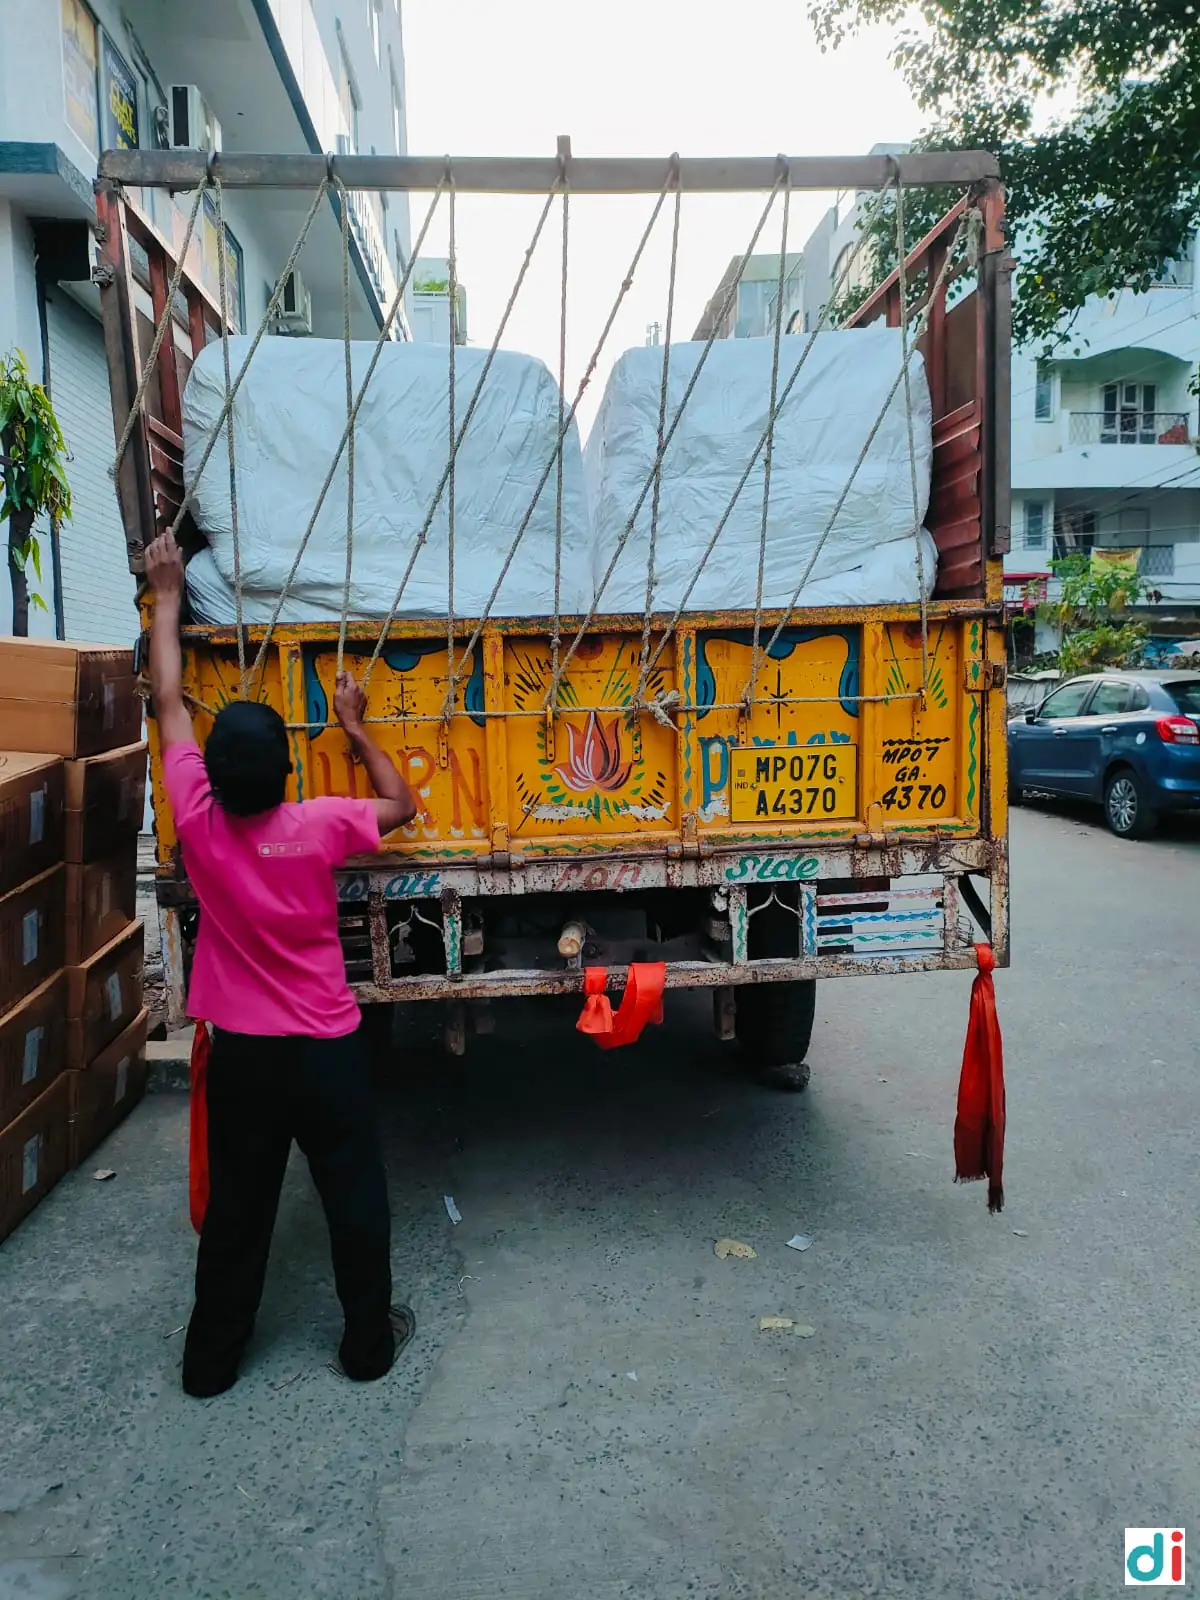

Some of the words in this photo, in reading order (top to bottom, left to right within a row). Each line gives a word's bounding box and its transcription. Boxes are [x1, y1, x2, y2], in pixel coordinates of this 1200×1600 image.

[755, 753, 838, 783] MP07G
[882, 746, 940, 764] MP07
[316, 746, 486, 838] HRN
[734, 781, 749, 790] IND
[882, 784, 946, 811] 4370
[755, 786, 836, 816] A4370
